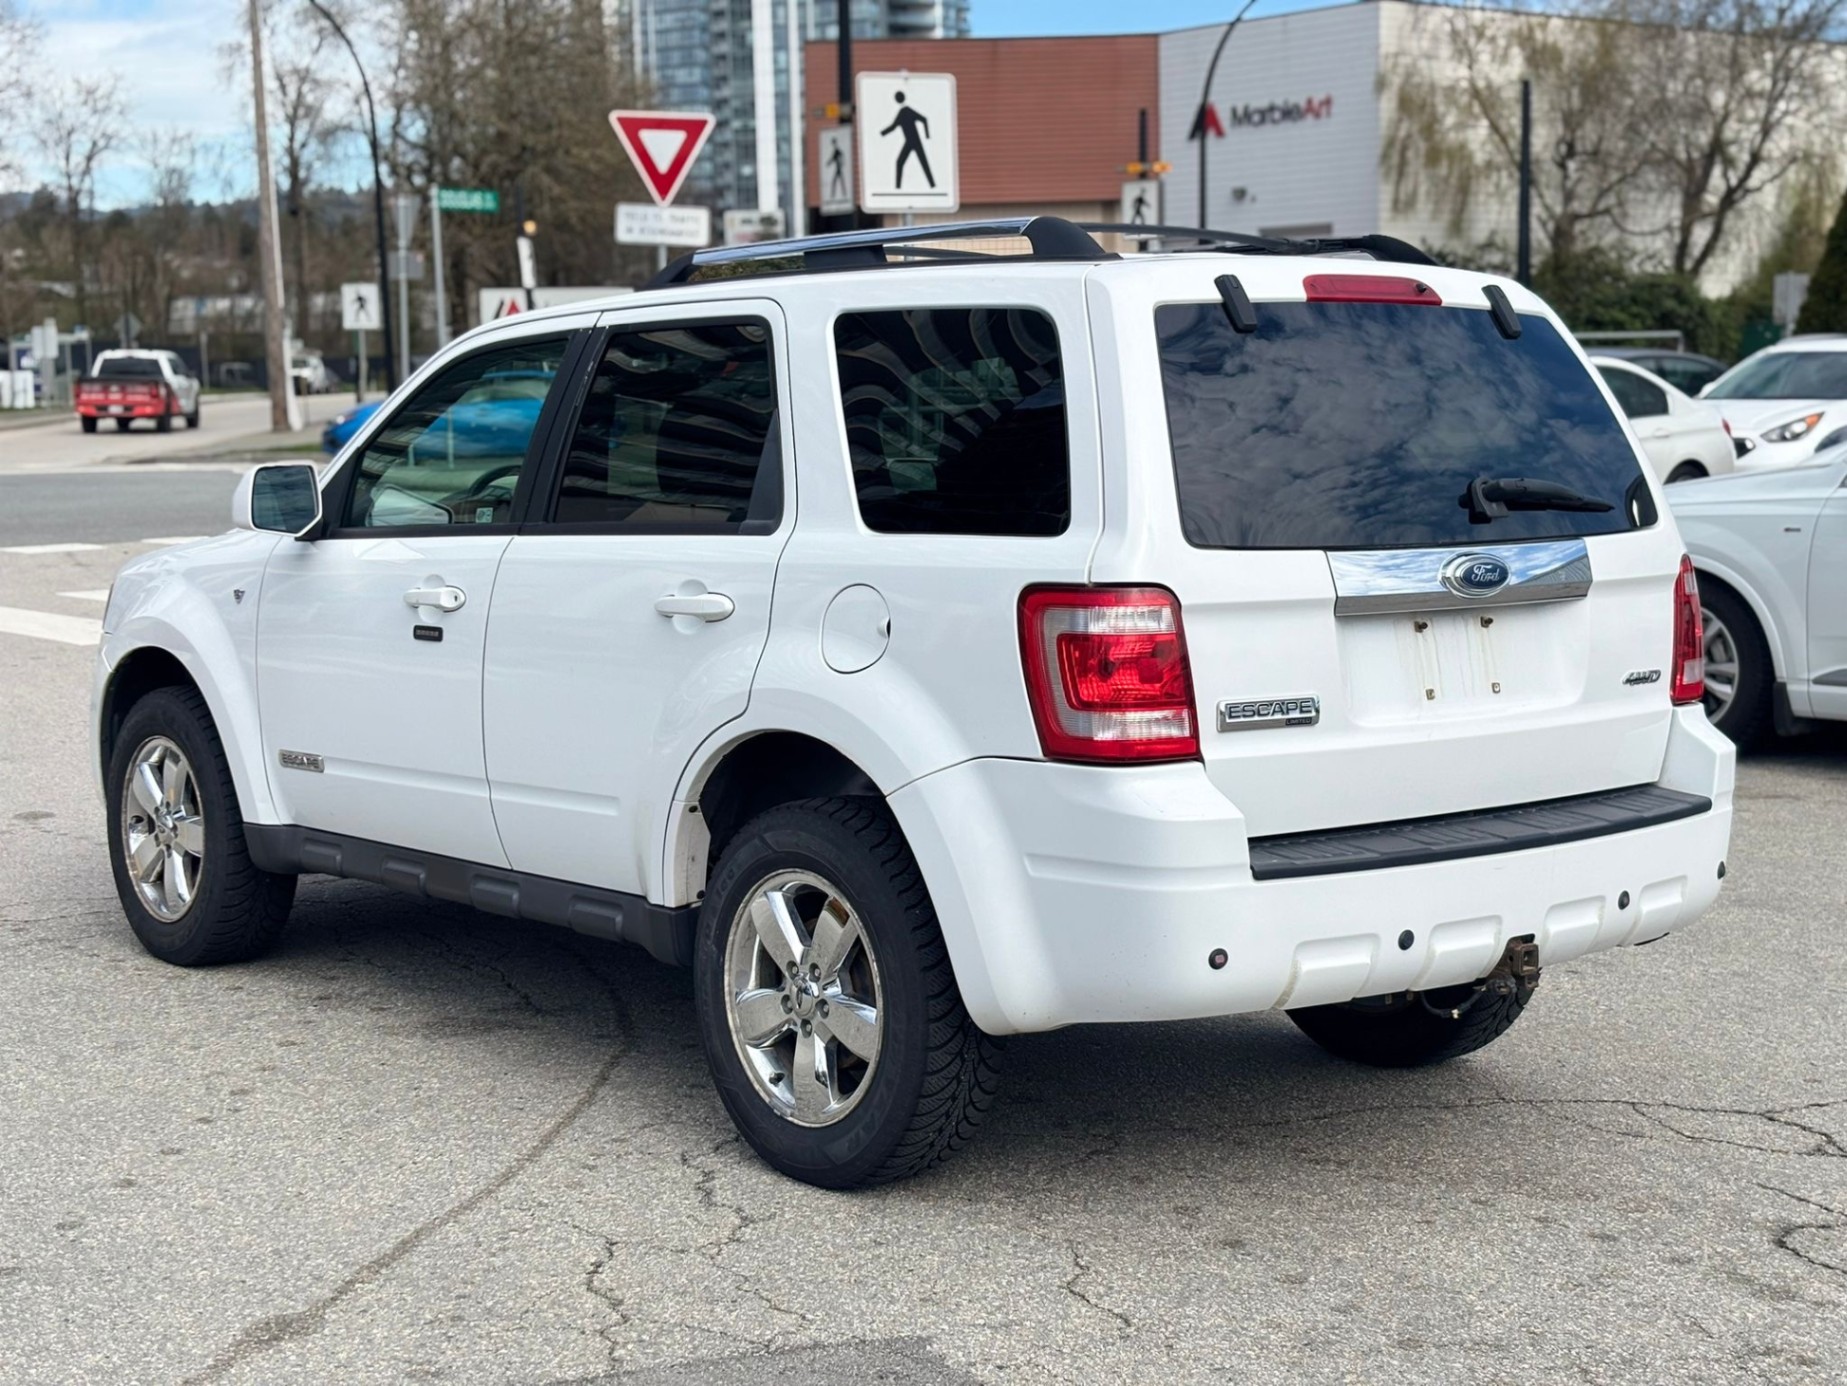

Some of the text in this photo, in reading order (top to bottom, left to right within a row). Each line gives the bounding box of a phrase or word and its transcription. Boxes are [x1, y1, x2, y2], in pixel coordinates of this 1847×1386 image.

[1230, 94, 1332, 127] MarbleArt
[1471, 564, 1500, 582] Ford
[1226, 699, 1313, 720] ESCAPE
